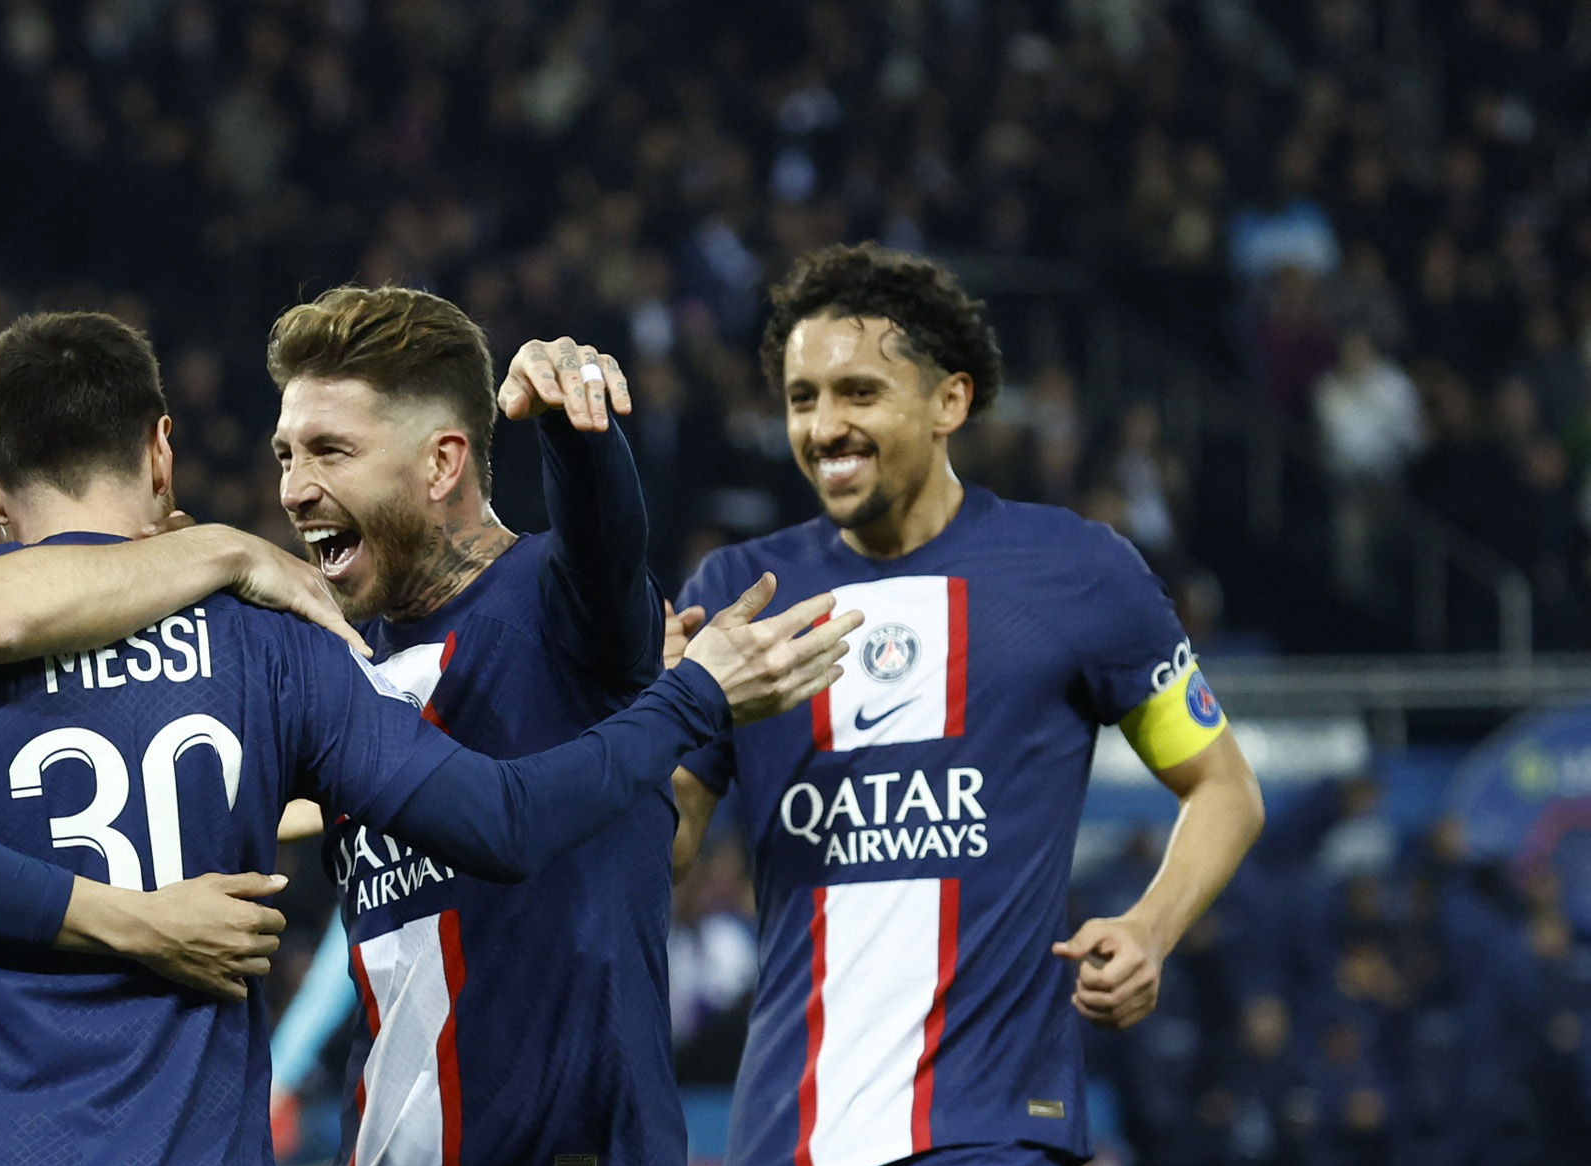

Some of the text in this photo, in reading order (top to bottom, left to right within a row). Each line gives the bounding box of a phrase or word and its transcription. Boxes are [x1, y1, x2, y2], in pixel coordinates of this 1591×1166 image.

[780, 767, 987, 846] QATAR
[824, 823, 989, 867] AIRWAYS
[356, 856, 455, 915] AIRWA
